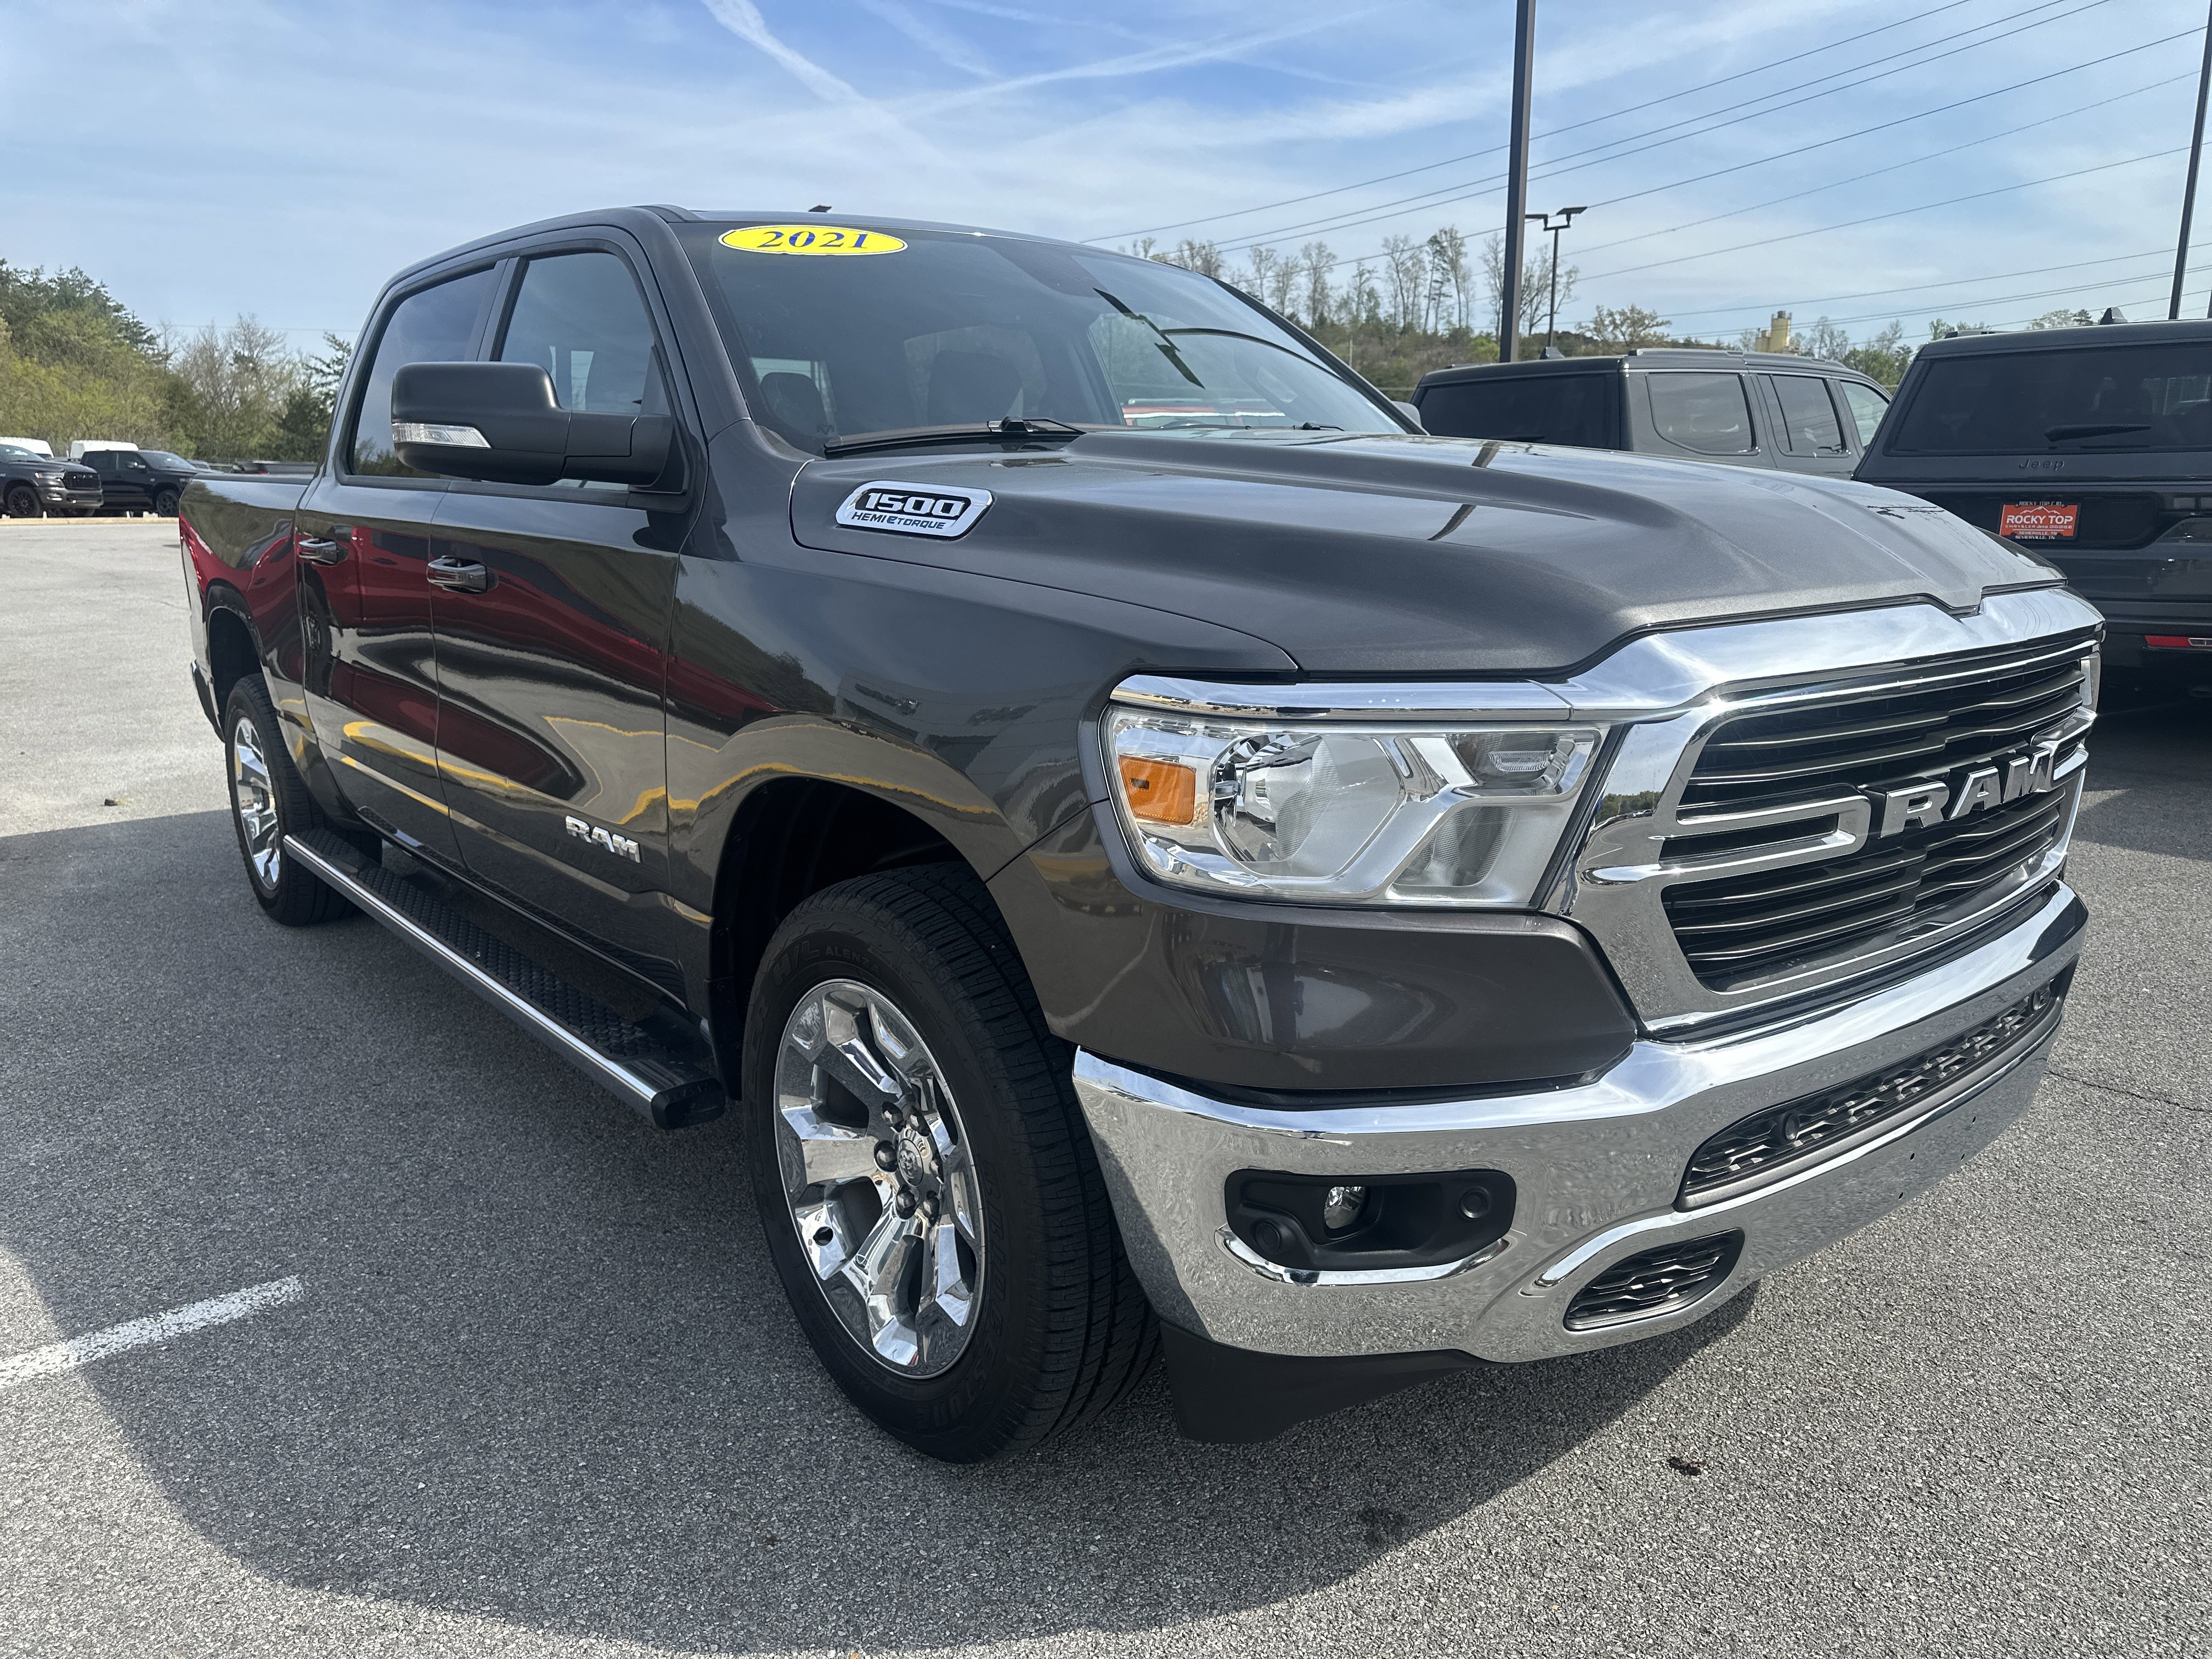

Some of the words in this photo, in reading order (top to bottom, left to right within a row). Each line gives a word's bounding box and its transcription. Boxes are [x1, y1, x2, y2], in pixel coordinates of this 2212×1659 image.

[757, 230, 868, 249] 2021
[2019, 459, 2065, 471] Jeep
[851, 511, 887, 523] HEMI
[864, 492, 966, 517] 1500
[2006, 515, 2046, 524] ROCKY
[2049, 516, 2073, 524] TOP
[1879, 747, 2051, 839] RAM
[565, 815, 641, 864] RAM
[772, 940, 821, 987] H/L
[825, 946, 881, 976] ALENZA
[916, 1158, 1007, 1429] BRIDGESTONE
